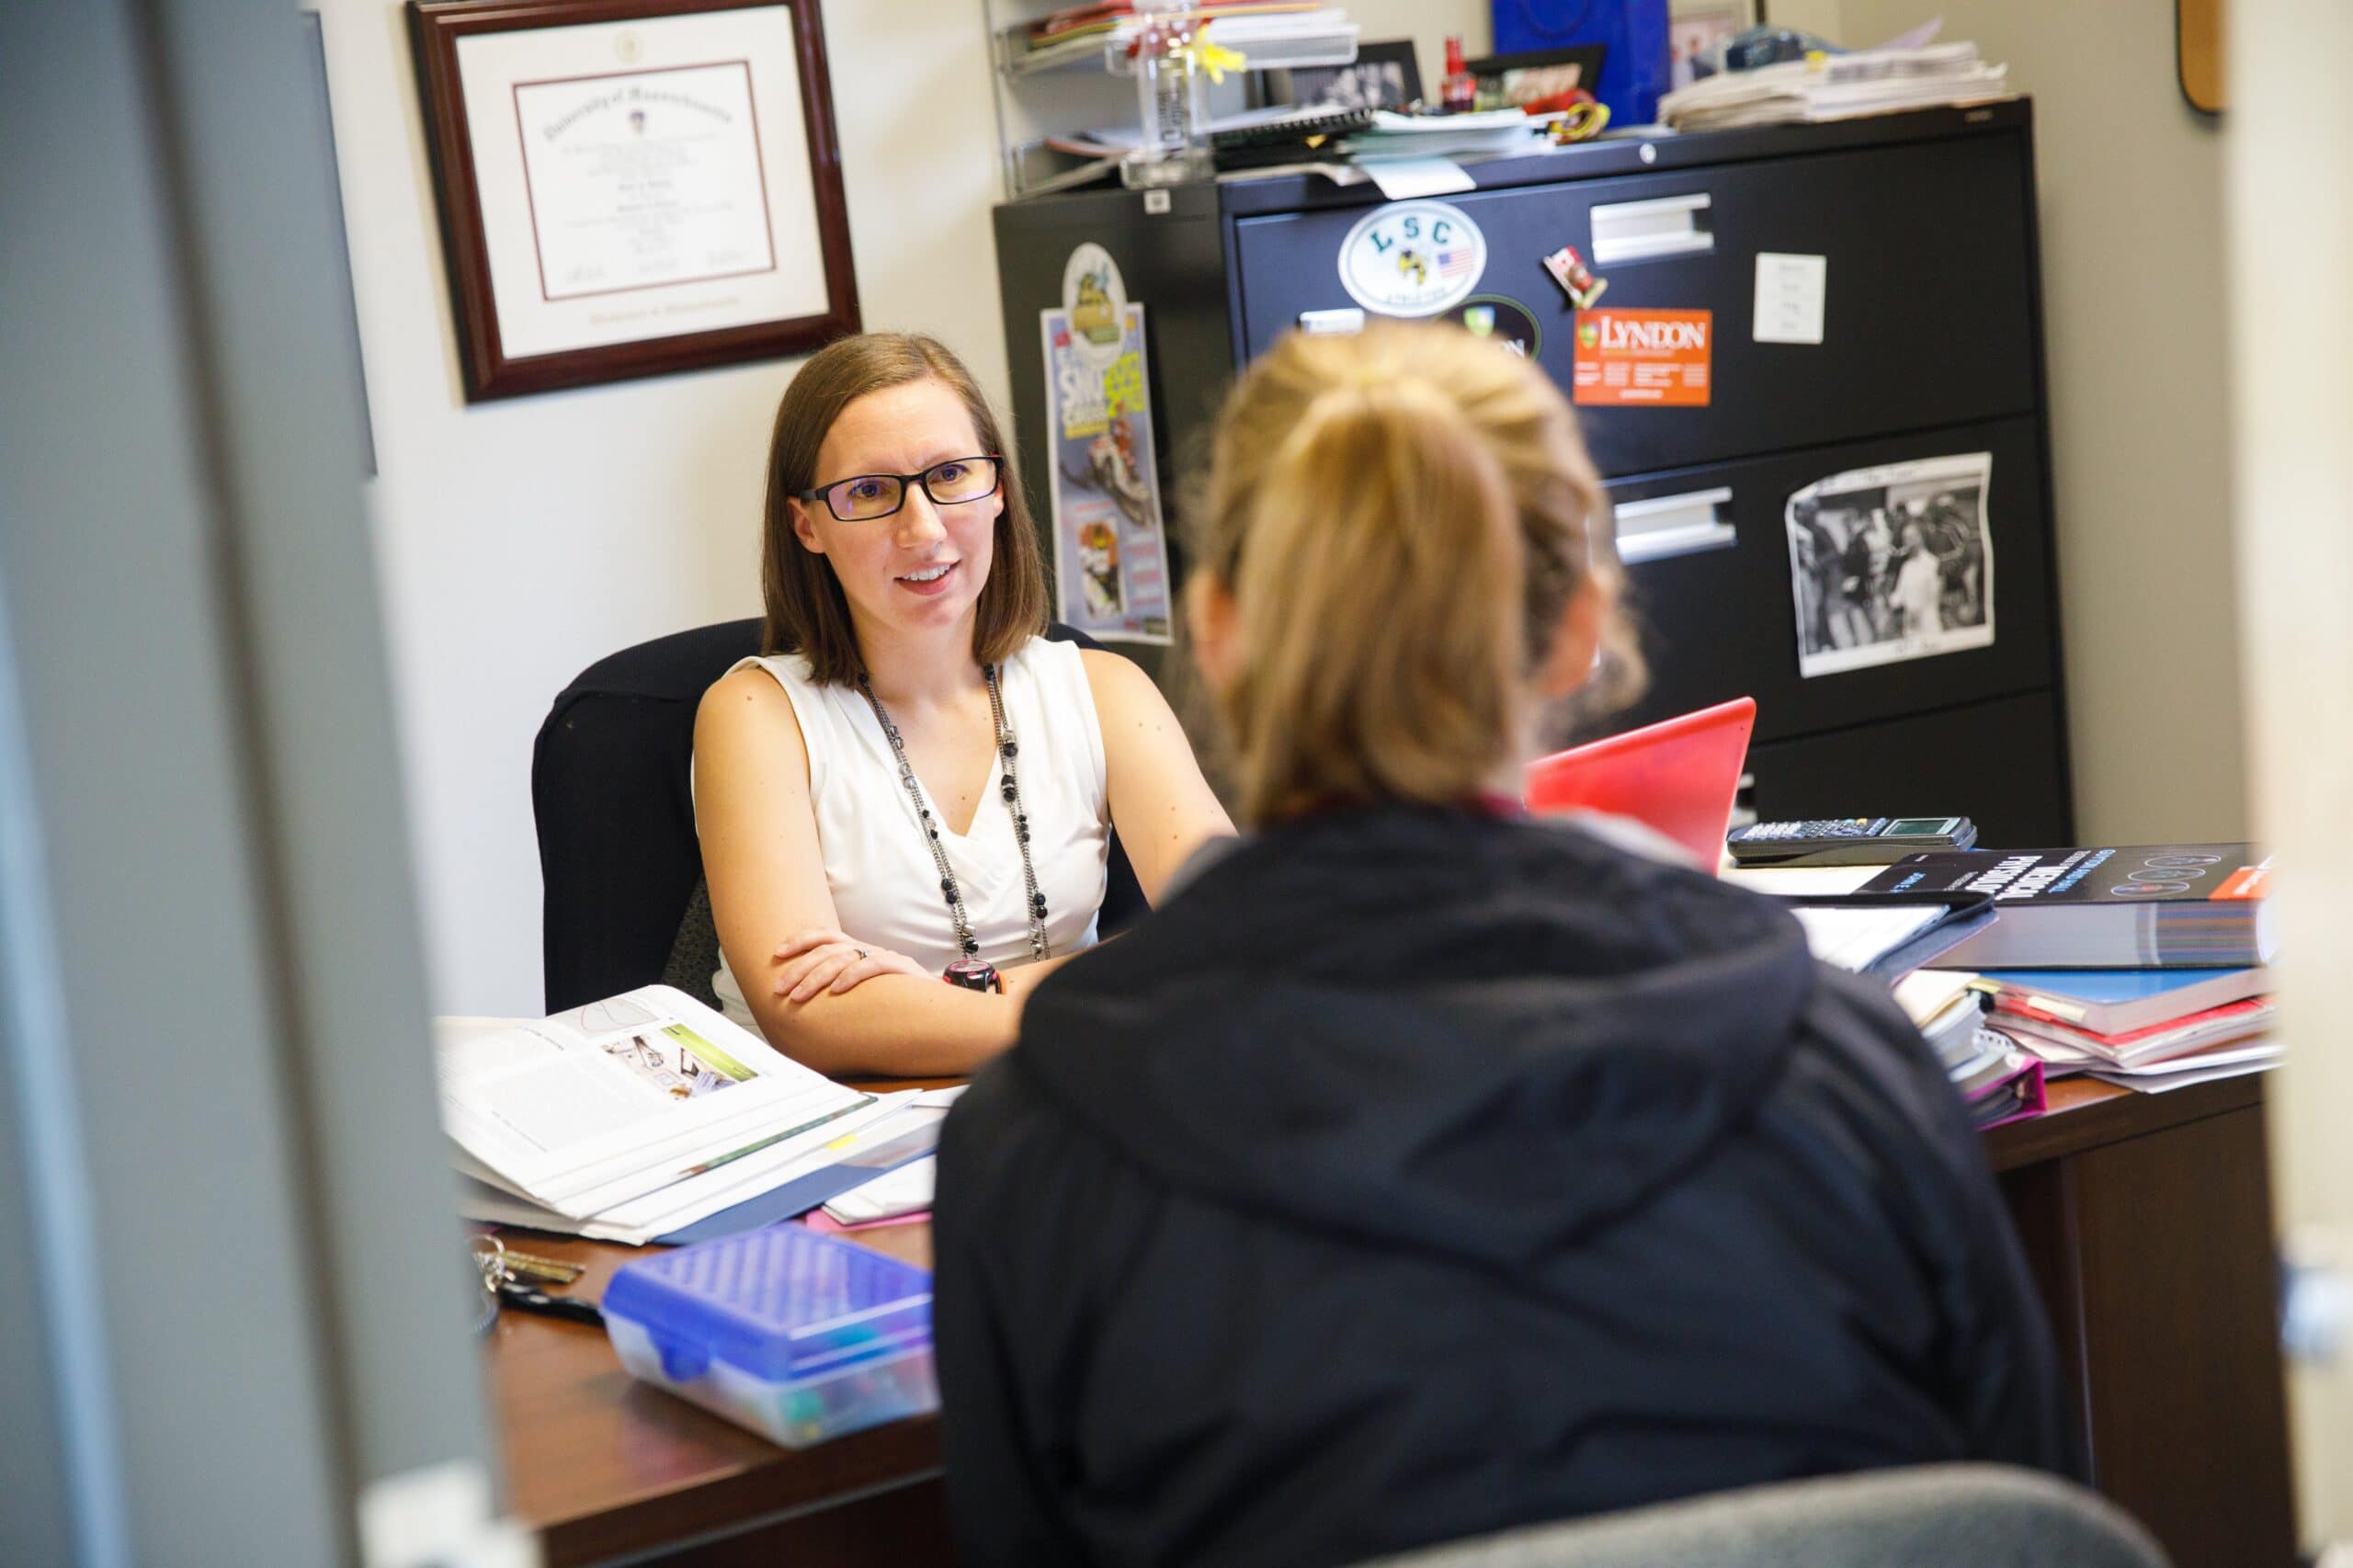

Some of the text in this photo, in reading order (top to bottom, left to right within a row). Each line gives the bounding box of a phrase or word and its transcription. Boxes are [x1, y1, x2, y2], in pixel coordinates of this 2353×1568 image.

[1370, 217, 1450, 253] LSC
[1600, 315, 1706, 349] LYNDON
[1963, 855, 2043, 894] PHYSIOLO
[1994, 866, 2071, 901] MEDICAL
